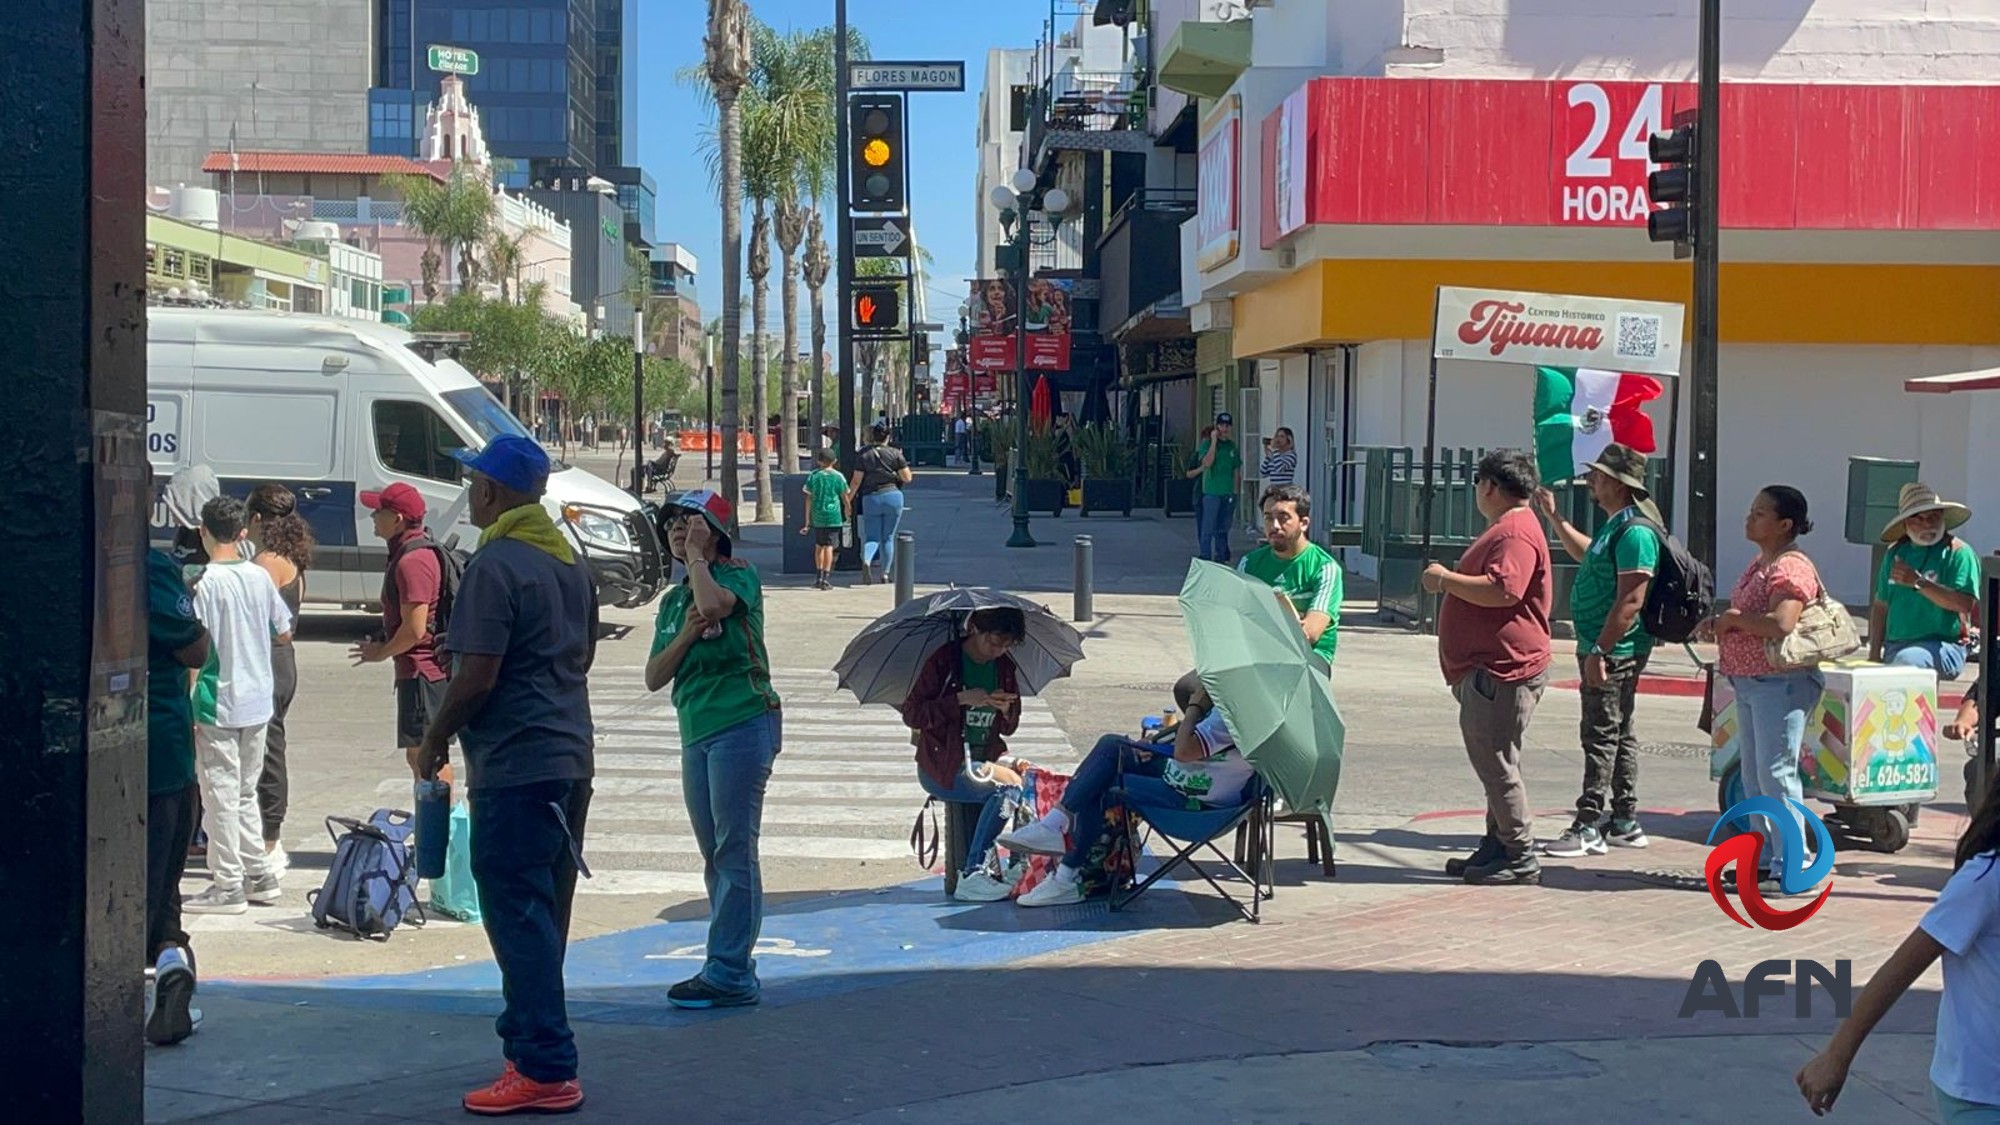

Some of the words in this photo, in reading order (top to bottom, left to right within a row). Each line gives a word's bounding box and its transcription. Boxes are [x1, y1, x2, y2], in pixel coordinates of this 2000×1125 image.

[857, 70, 906, 82] FLORES
[911, 70, 956, 82] MAGON
[1566, 83, 1673, 177] 24
[1563, 185, 1670, 221] HORA
[857, 232, 868, 242] UN
[869, 232, 901, 242] SENTIDO
[1528, 306, 1560, 318] CENTRO
[1458, 300, 1604, 356] Tijuana
[1877, 763, 1934, 787] 626-5821
